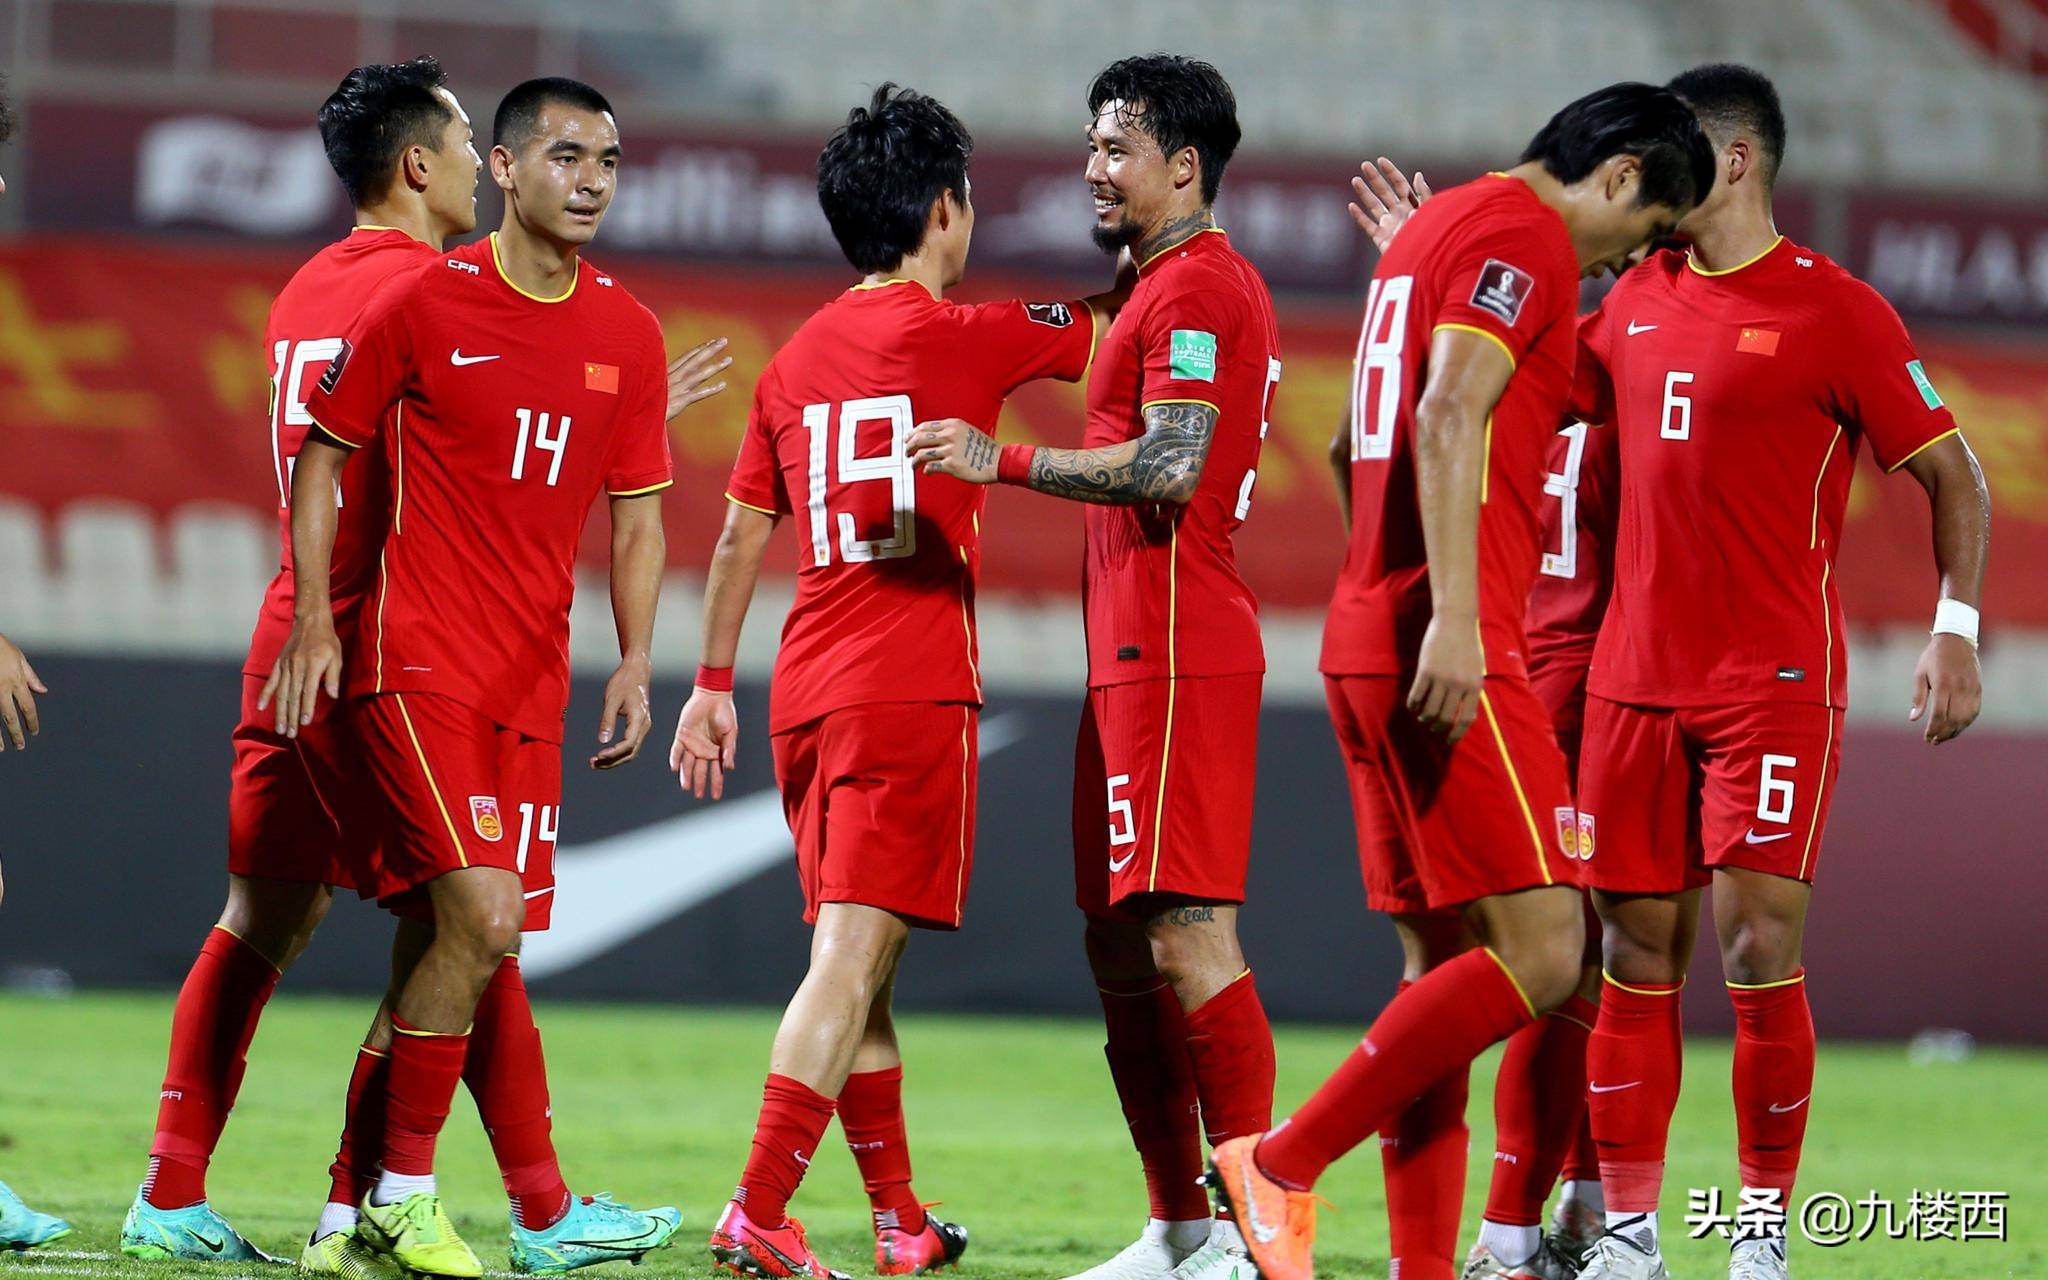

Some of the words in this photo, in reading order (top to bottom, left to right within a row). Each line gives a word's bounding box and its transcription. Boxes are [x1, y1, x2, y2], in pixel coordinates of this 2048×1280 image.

[447, 259, 480, 276] CFA
[1350, 275, 1414, 462] 18
[1660, 370, 1695, 441] 6
[510, 407, 572, 487] 14
[802, 394, 917, 568] 19
[1107, 773, 1136, 846] 5
[1756, 753, 1797, 824] 6
[516, 803, 560, 876] 14
